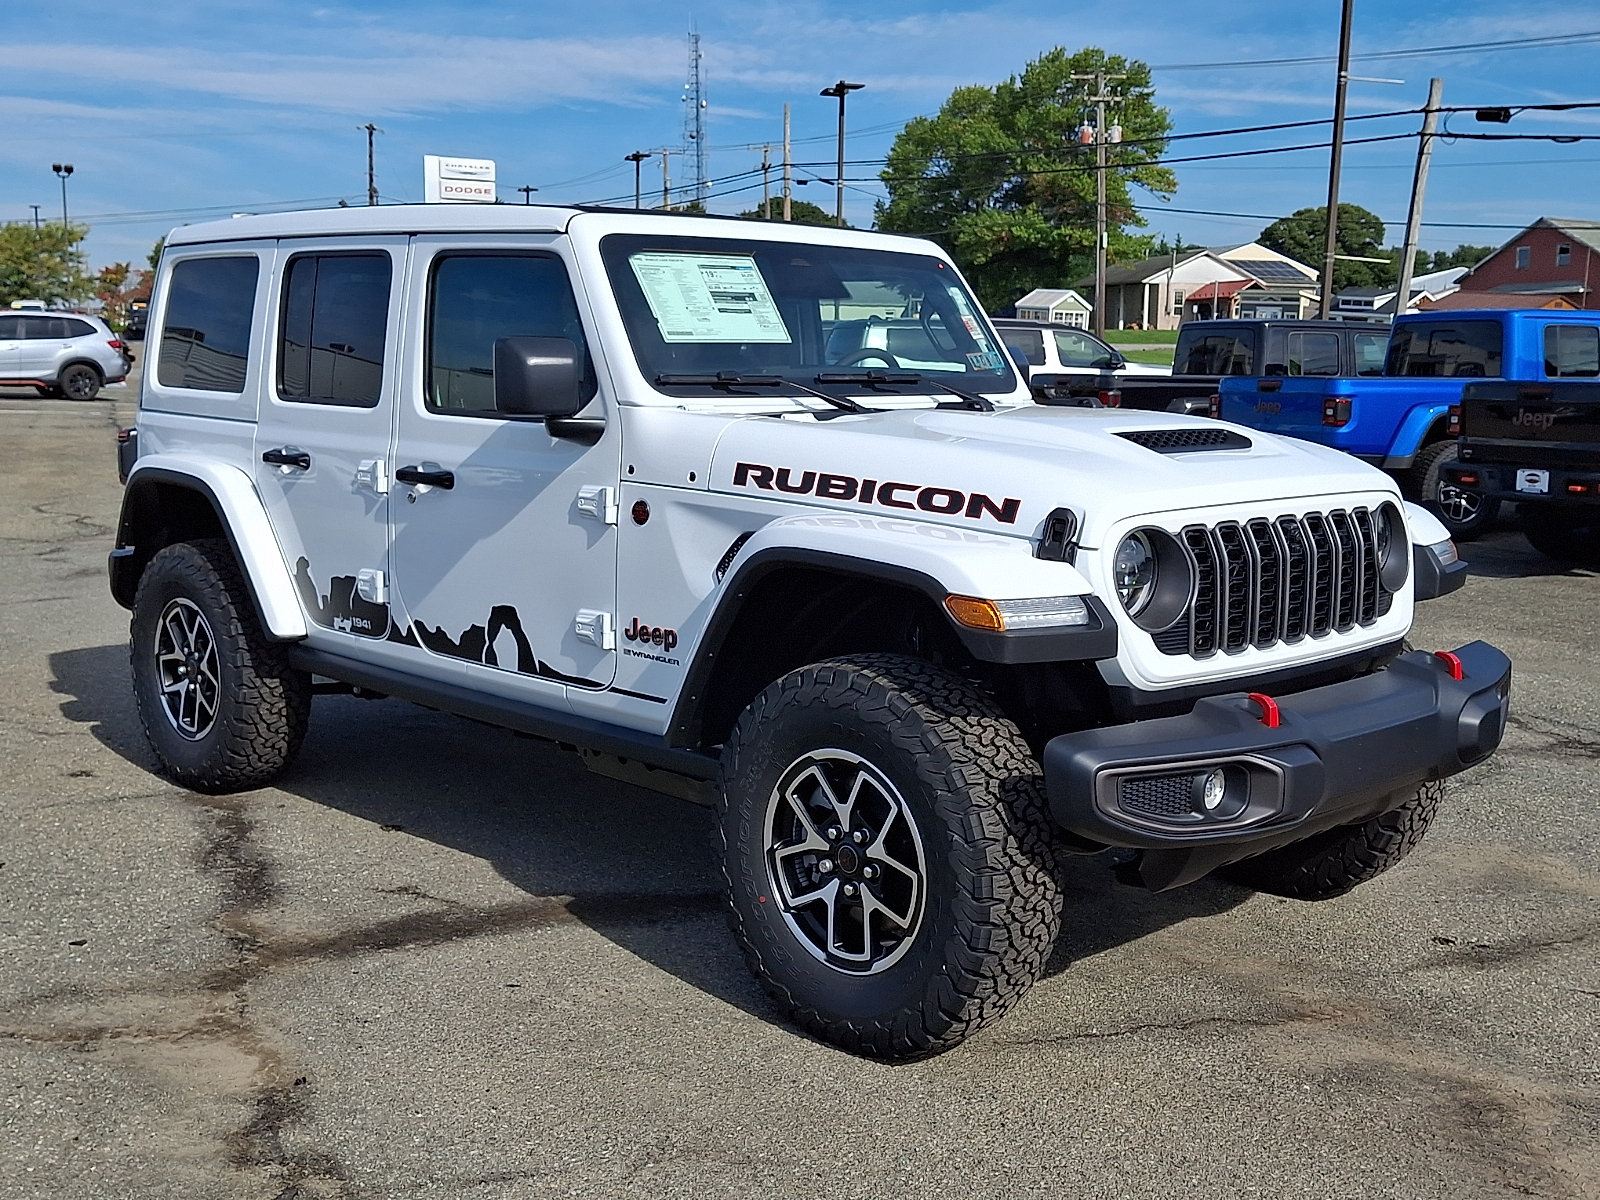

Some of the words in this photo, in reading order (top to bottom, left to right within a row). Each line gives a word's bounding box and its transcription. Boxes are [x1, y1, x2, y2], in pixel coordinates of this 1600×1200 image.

[444, 185, 492, 195] DODGE
[1253, 399, 1282, 416] Jeep
[1512, 408, 1554, 430] Jeep
[732, 462, 1022, 525] RUBICON
[353, 616, 371, 630] 1941
[624, 616, 678, 653] Jeep
[632, 649, 680, 667] WRANGLER
